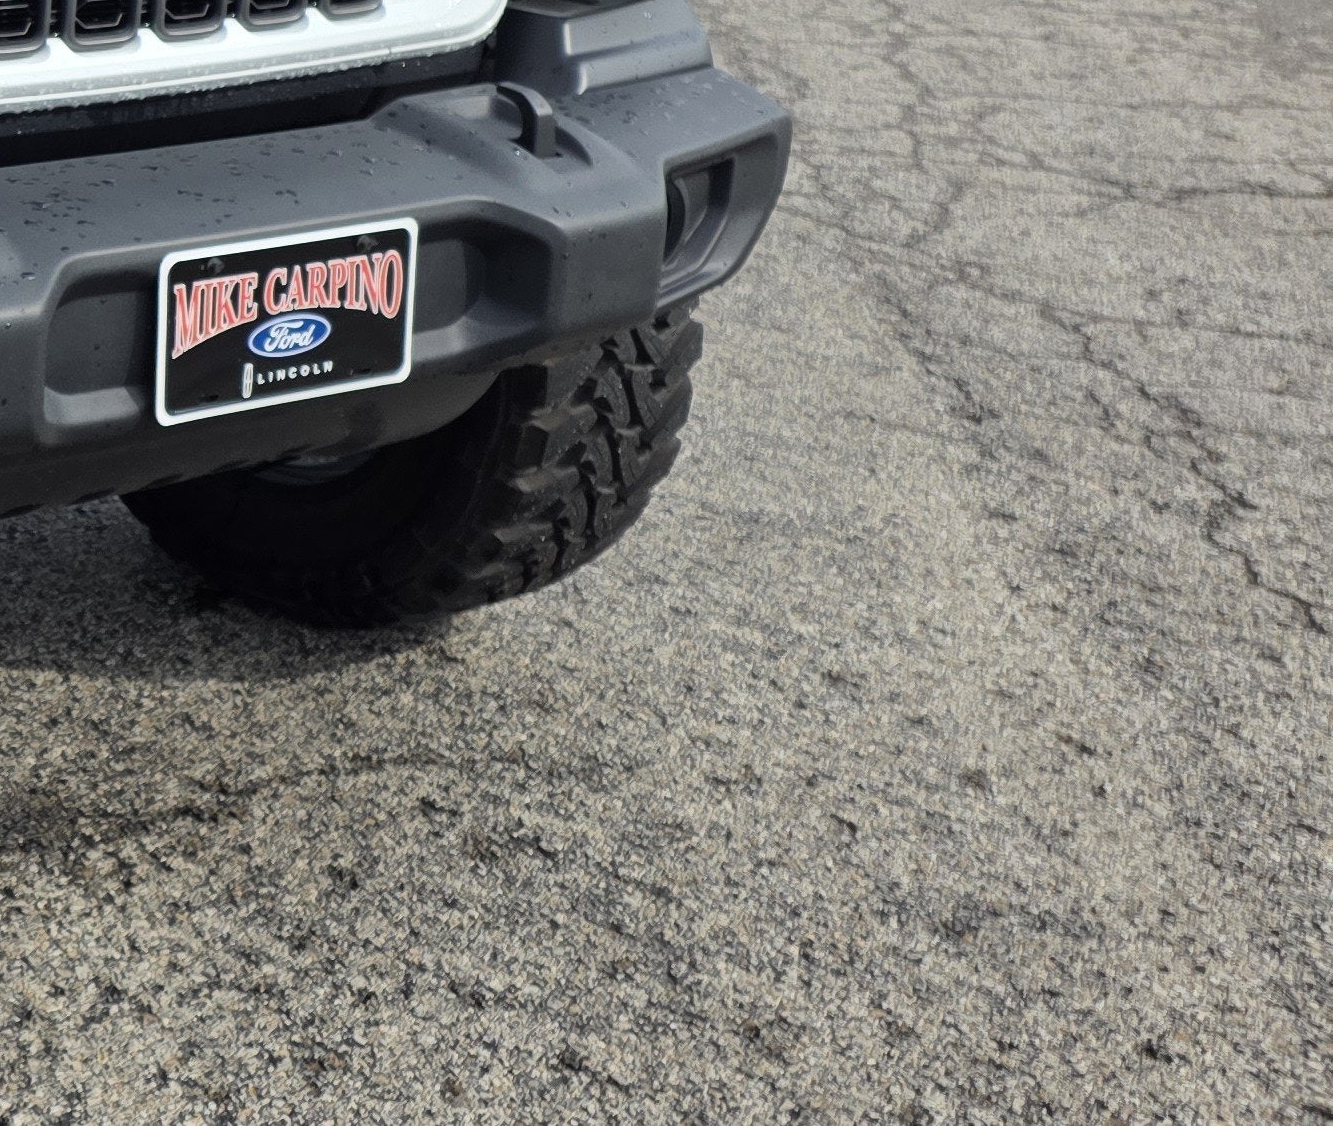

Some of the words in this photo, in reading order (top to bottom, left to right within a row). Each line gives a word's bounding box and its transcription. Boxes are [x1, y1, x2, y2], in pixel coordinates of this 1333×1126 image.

[171, 272, 259, 360] MIKE
[263, 249, 404, 319] CARPINO
[263, 320, 316, 352] Ford
[257, 360, 334, 385] LINCOLN
